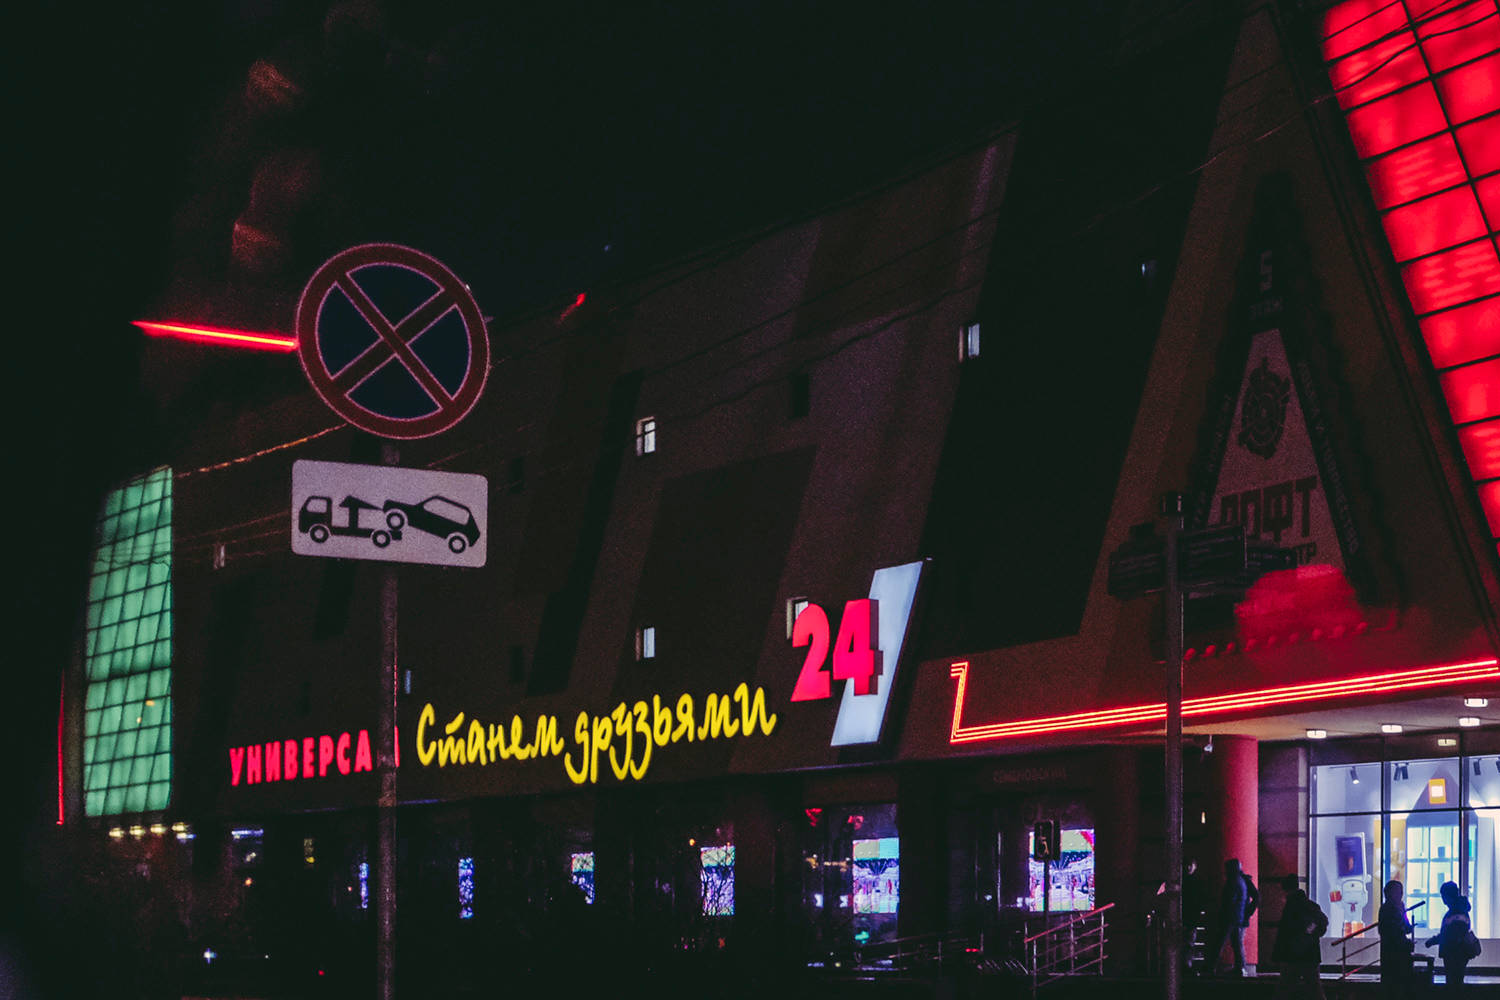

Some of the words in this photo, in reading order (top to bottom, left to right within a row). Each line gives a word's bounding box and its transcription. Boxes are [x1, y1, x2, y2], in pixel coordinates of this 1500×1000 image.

[790, 598, 875, 703] 24
[229, 725, 400, 788] УНИВЕРСА
[417, 704, 565, 768] Станем
[563, 682, 777, 785] друзьями
